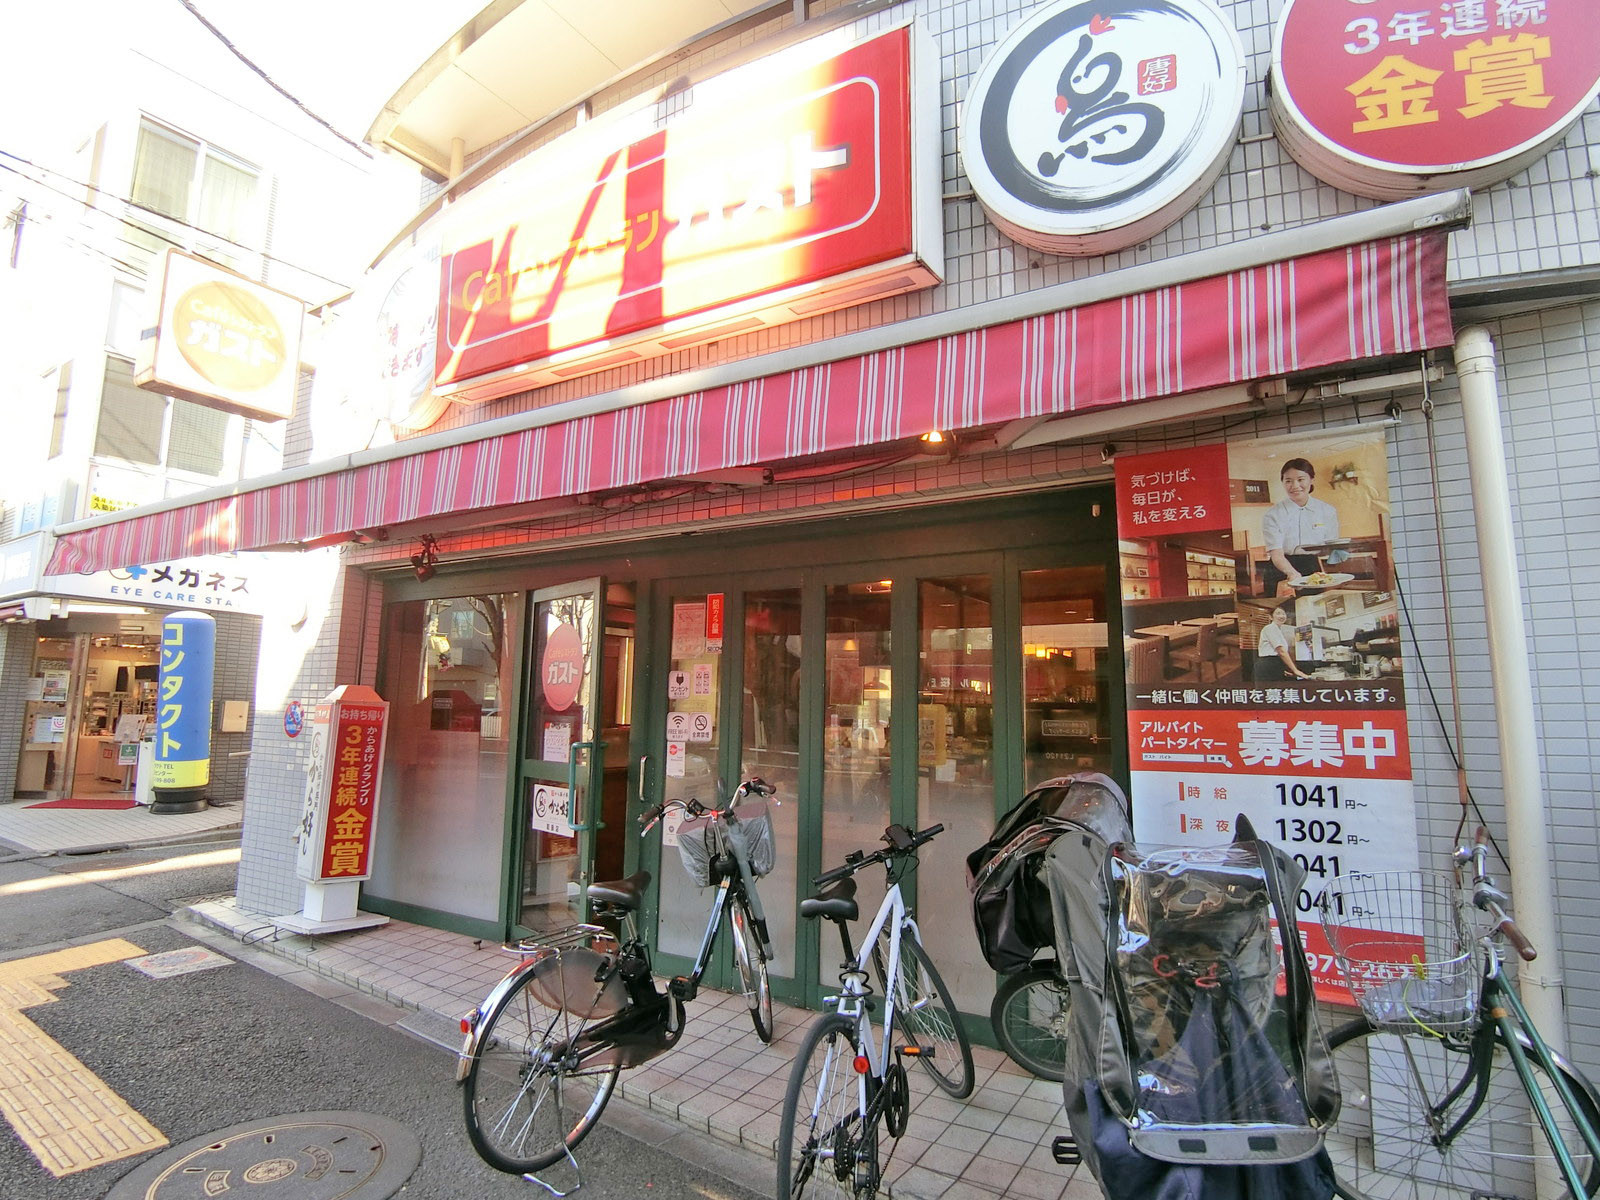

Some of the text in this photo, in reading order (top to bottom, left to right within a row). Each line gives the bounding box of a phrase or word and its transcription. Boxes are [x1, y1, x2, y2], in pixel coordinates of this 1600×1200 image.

[1343, 0, 1548, 55] 3年連続
[1142, 57, 1172, 95] 唐好
[1344, 33, 1555, 134] 金賞
[1131, 469, 1197, 488] 気づけば、
[1132, 488, 1183, 506] 毎日が、
[1133, 505, 1207, 525] 私を変える
[110, 585, 143, 597] EYE
[153, 590, 196, 603] CARE
[547, 660, 579, 685] ガスト
[160, 623, 186, 758] コンタクト
[1136, 687, 1397, 705] 一緒に働く仲間を募集しています。
[340, 709, 385, 722] お持ち帰り
[1140, 720, 1203, 733] アルバイト
[1141, 736, 1227, 750] パートタイマー
[1237, 719, 1397, 770] 募集中
[335, 724, 363, 807] 3年連続
[358, 725, 379, 807] からあげグランプリ
[1275, 782, 1339, 809] 1041
[328, 808, 368, 876] 金賞
[1275, 818, 1344, 845] 1302
